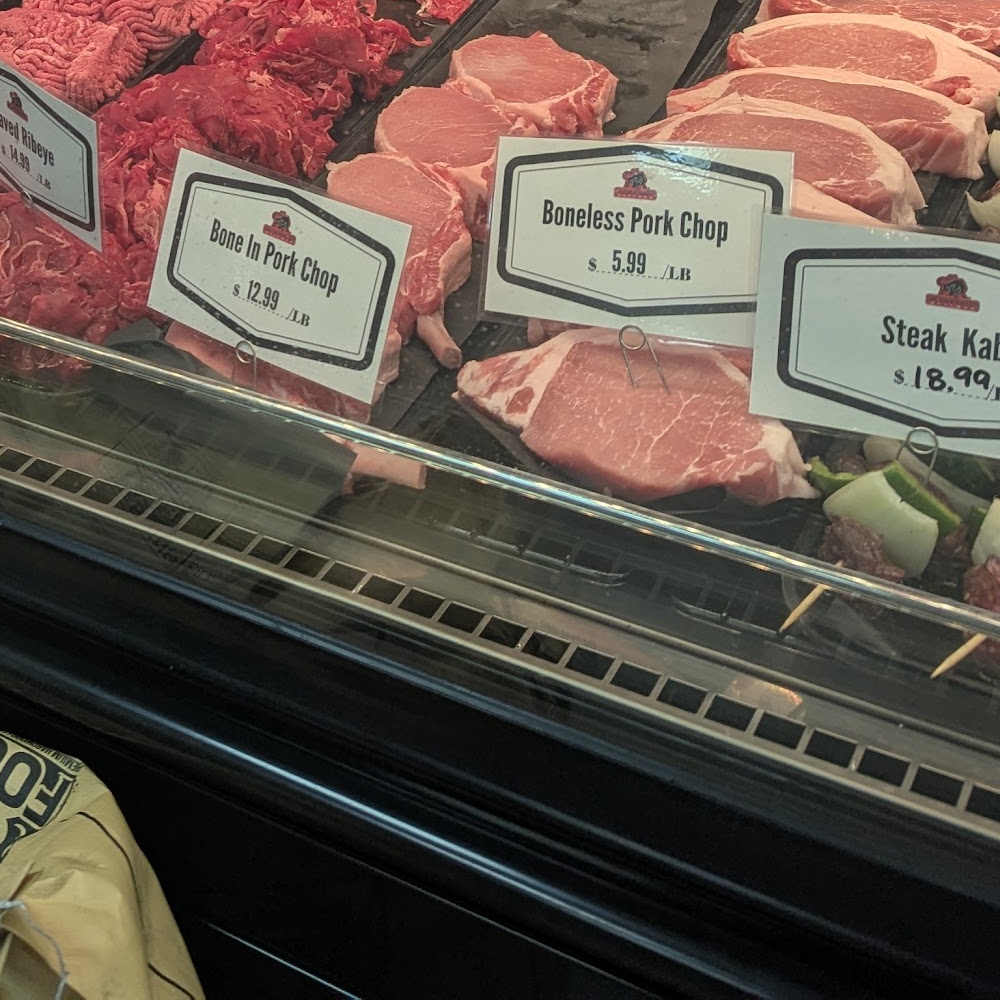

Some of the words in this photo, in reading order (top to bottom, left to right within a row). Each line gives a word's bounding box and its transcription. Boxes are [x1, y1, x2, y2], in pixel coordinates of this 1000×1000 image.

[9, 144, 30, 173] 14.99
[21, 126, 54, 167] Ribeye
[542, 198, 625, 232] Boneless
[630, 206, 675, 237] Pork
[680, 210, 728, 248] Chop
[209, 218, 243, 254] Bone
[246, 234, 261, 262] In
[263, 241, 298, 279] Pork
[300, 256, 339, 298] Chop
[612, 249, 647, 275] 5.99
[662, 264, 691, 281] /LB
[246, 279, 280, 311] 12.99
[286, 306, 310, 328] /LB
[881, 315, 948, 354] Steak
